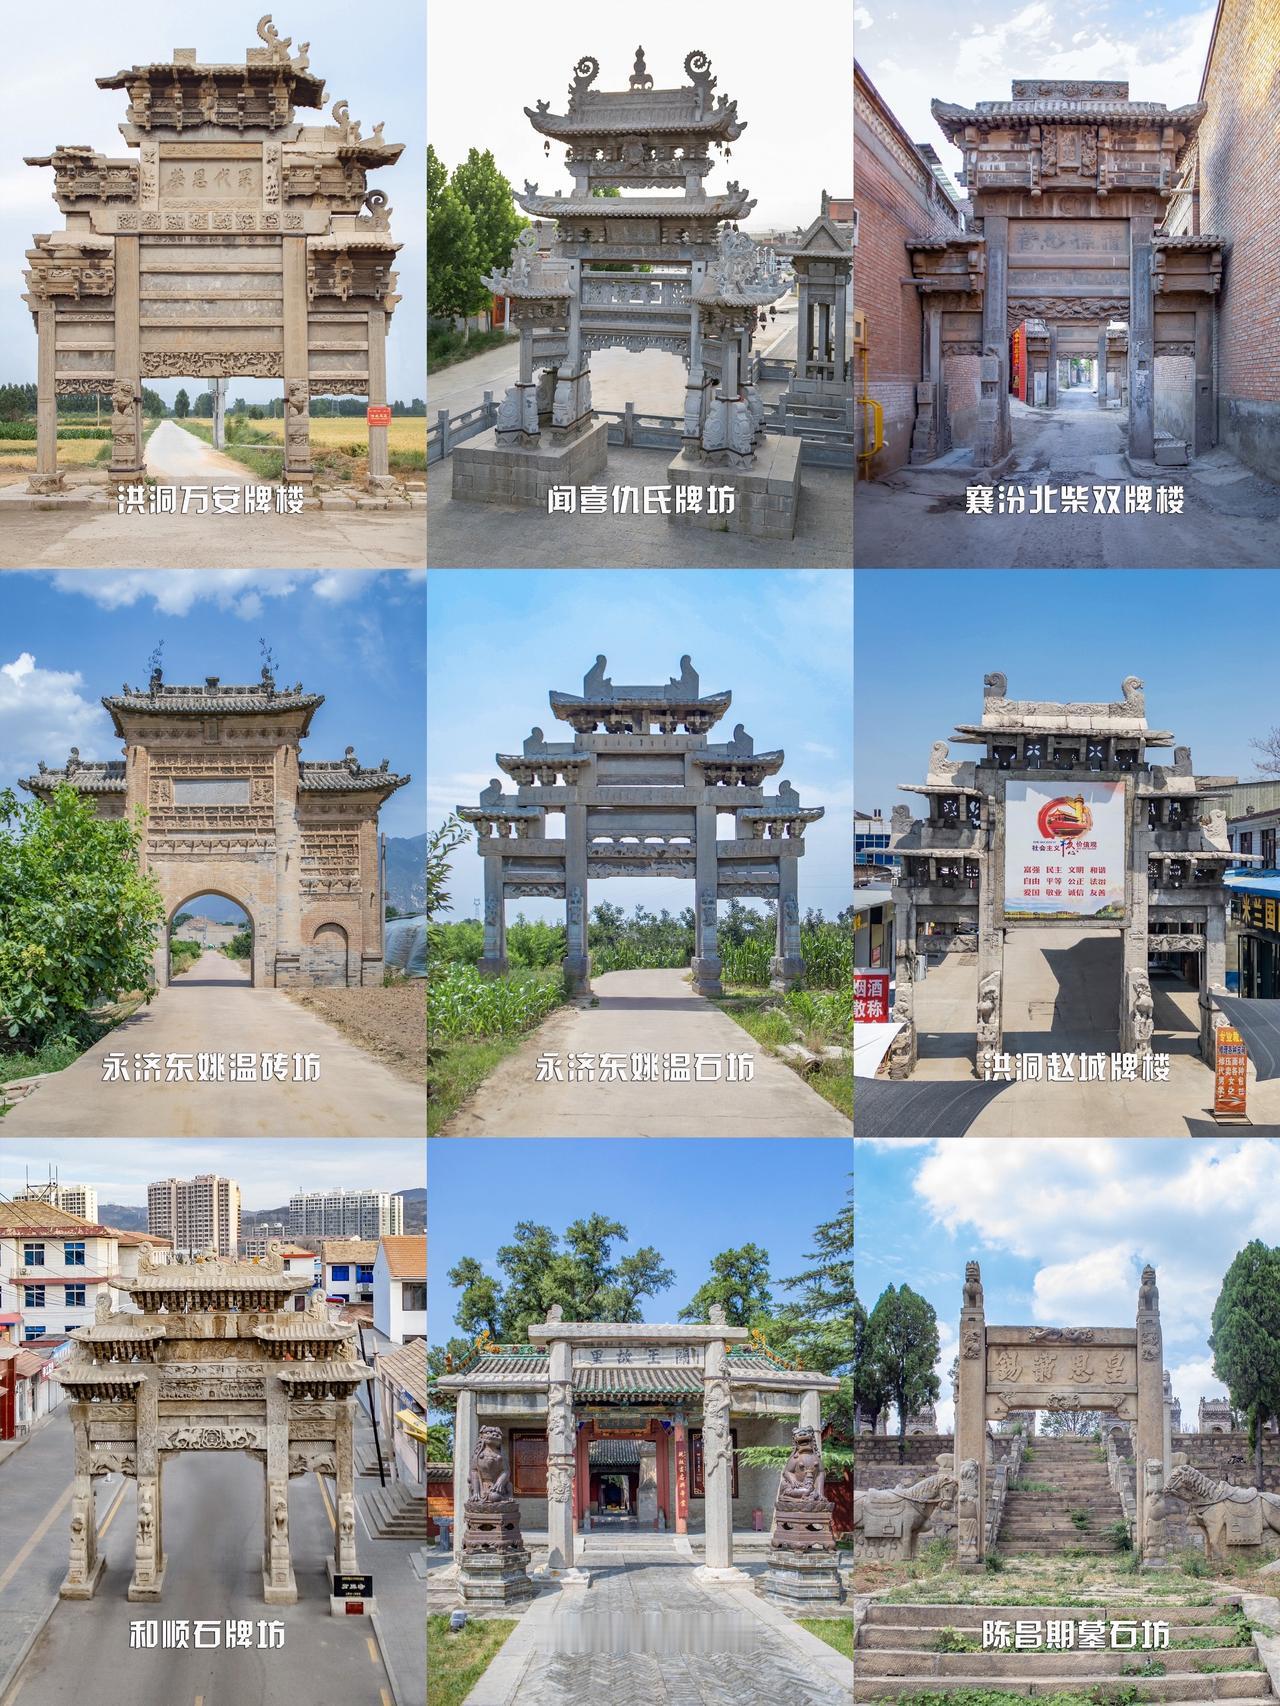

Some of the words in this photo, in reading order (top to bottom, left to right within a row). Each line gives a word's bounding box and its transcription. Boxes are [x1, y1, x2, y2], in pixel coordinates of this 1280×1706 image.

[1023, 866, 1040, 874] 富强
[1046, 866, 1063, 874] 民主
[1068, 866, 1085, 874] 文明
[1090, 866, 1107, 874] 和谐
[1023, 877, 1040, 886] 自由
[1046, 877, 1063, 886] 平等
[1068, 877, 1085, 886] 公正
[1090, 877, 1107, 886] 法治
[1023, 888, 1040, 897] 爱国
[1046, 888, 1063, 897] 敬业
[1068, 888, 1085, 897] 诚信
[1090, 888, 1107, 897] 友善
[1242, 892, 1280, 932] 米兰国
[854, 979, 883, 997] 烟酒
[854, 1000, 883, 1018] 散称
